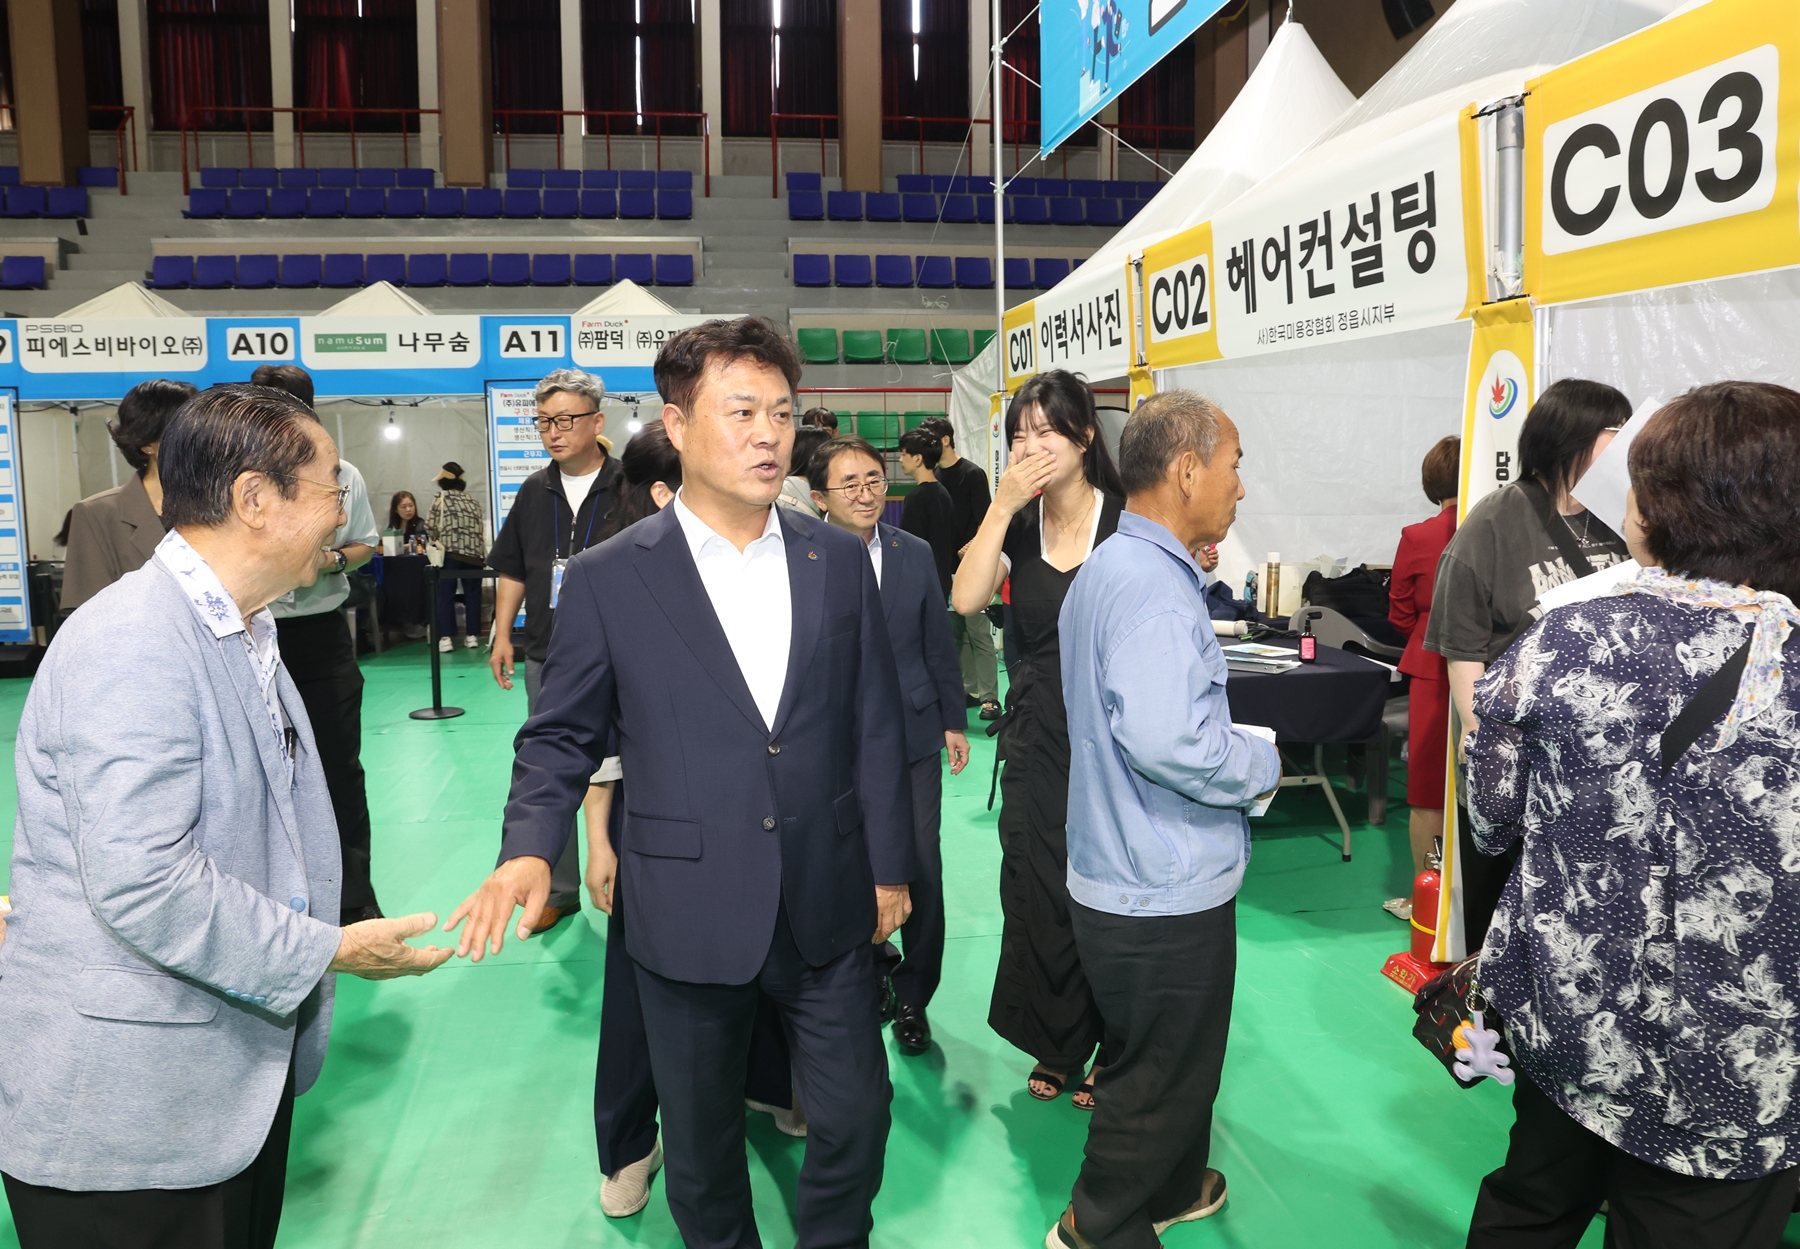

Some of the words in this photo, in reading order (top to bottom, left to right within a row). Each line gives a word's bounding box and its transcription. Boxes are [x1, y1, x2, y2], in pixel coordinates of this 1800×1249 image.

[1549, 70, 1764, 236] C03
[1225, 169, 1437, 314] 헤어컨설팅
[1152, 263, 1208, 335] C02
[25, 324, 83, 333] PSBIO
[1040, 288, 1122, 363] 이력서사진
[231, 333, 289, 356] A10
[317, 336, 384, 345] namuSum
[398, 331, 471, 353] 나무숨
[503, 330, 559, 353] A11
[1009, 327, 1033, 372] C01
[503, 399, 538, 407] (주)유피에
